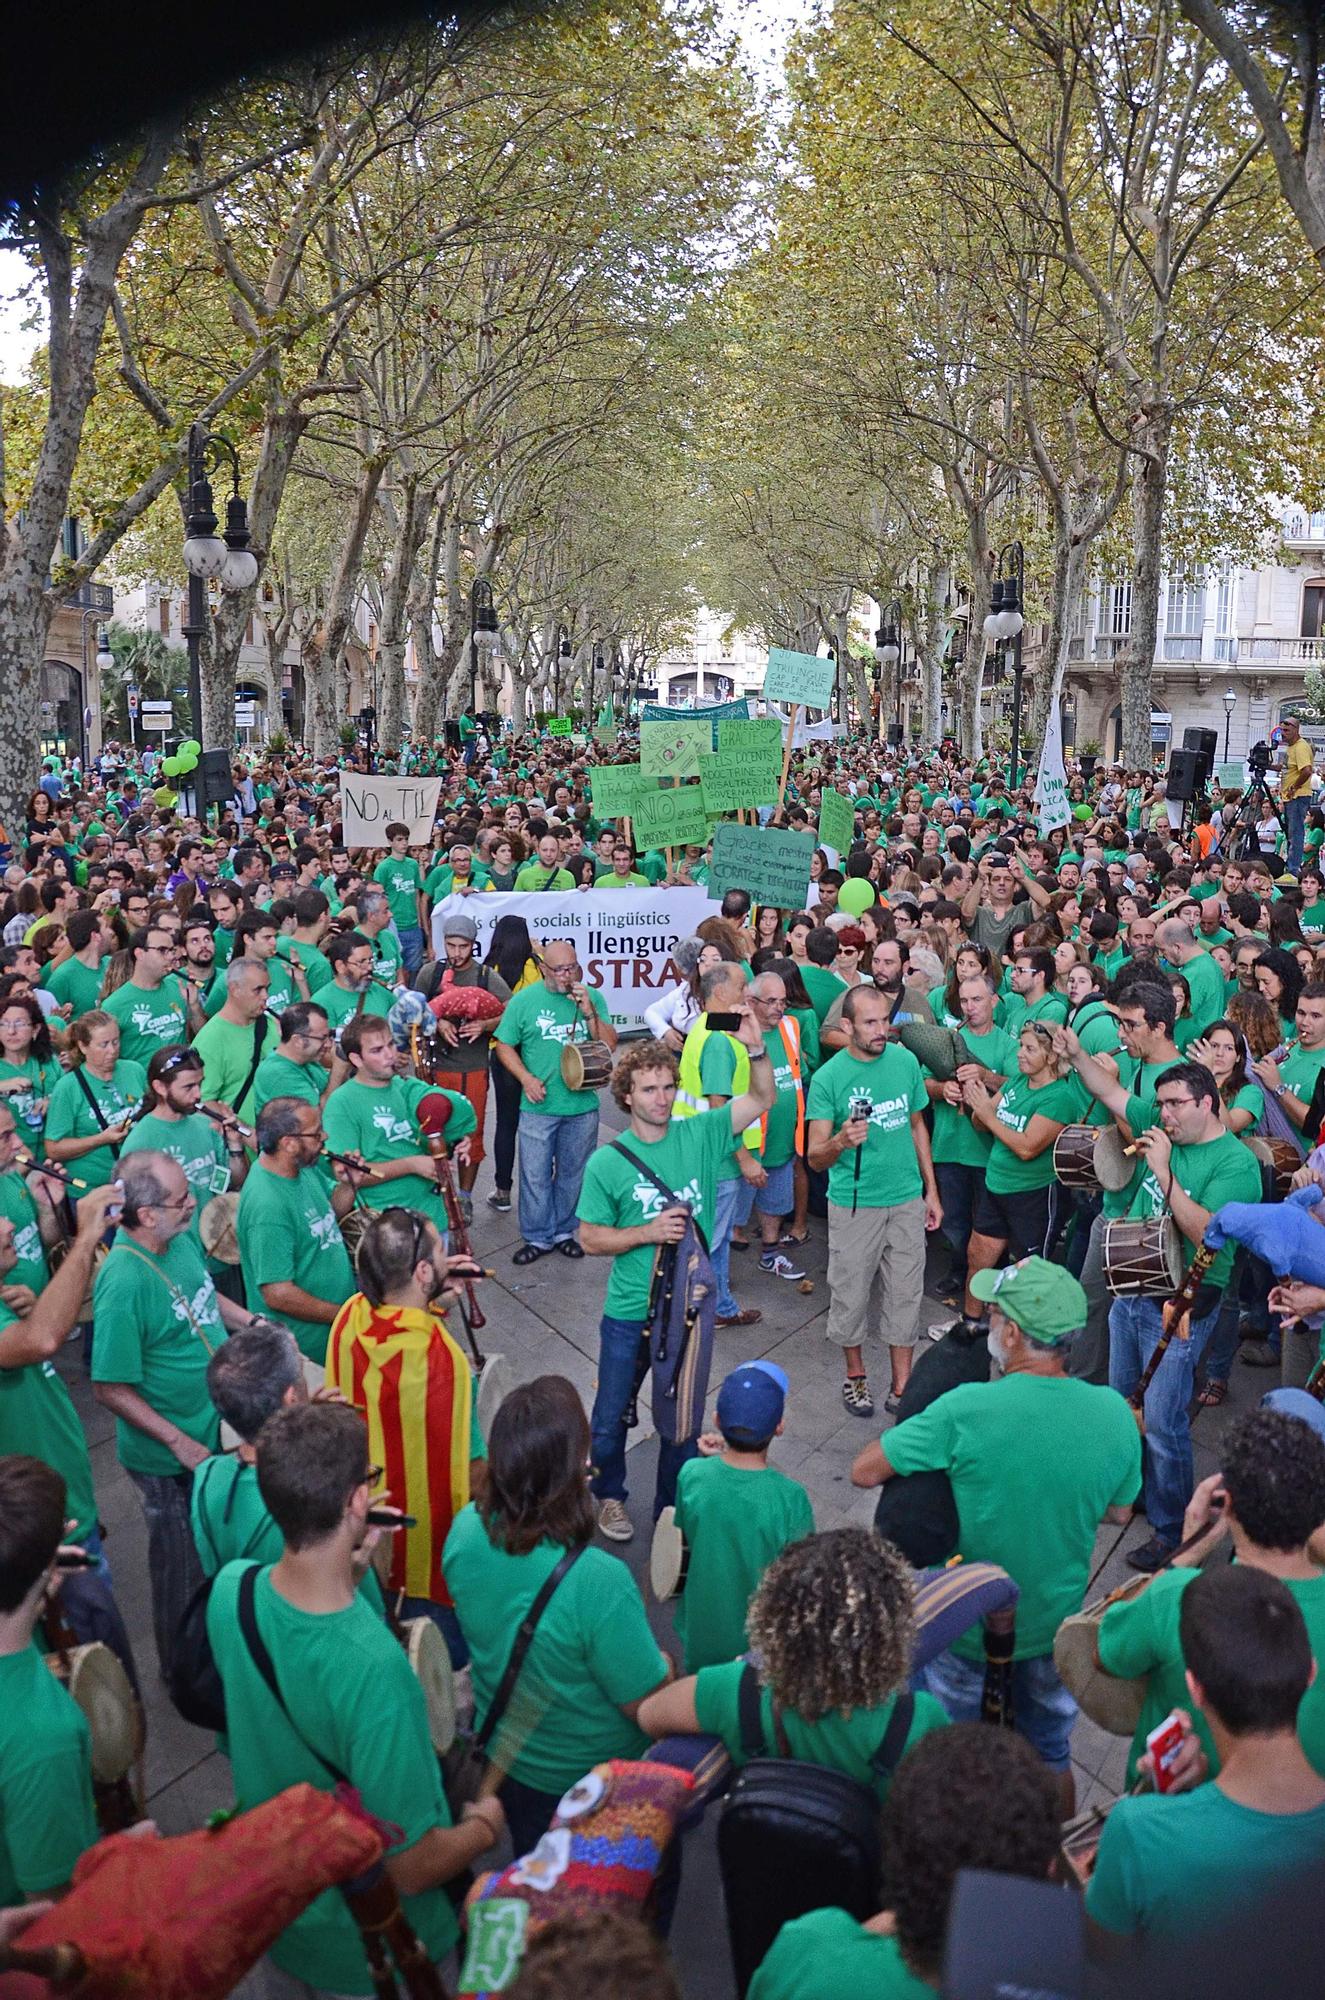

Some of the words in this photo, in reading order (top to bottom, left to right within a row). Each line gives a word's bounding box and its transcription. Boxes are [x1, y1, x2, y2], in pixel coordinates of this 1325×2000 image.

[715, 754, 733, 767] ELS
[1043, 778, 1063, 793] UNA
[346, 787, 379, 822] NO
[634, 794, 675, 827] NO
[1041, 795, 1064, 807] LICA
[533, 912, 581, 928] socials
[587, 912, 592, 926] i
[598, 911, 671, 929] lingüístics
[588, 931, 679, 958] llengua
[579, 958, 683, 989] STRA
